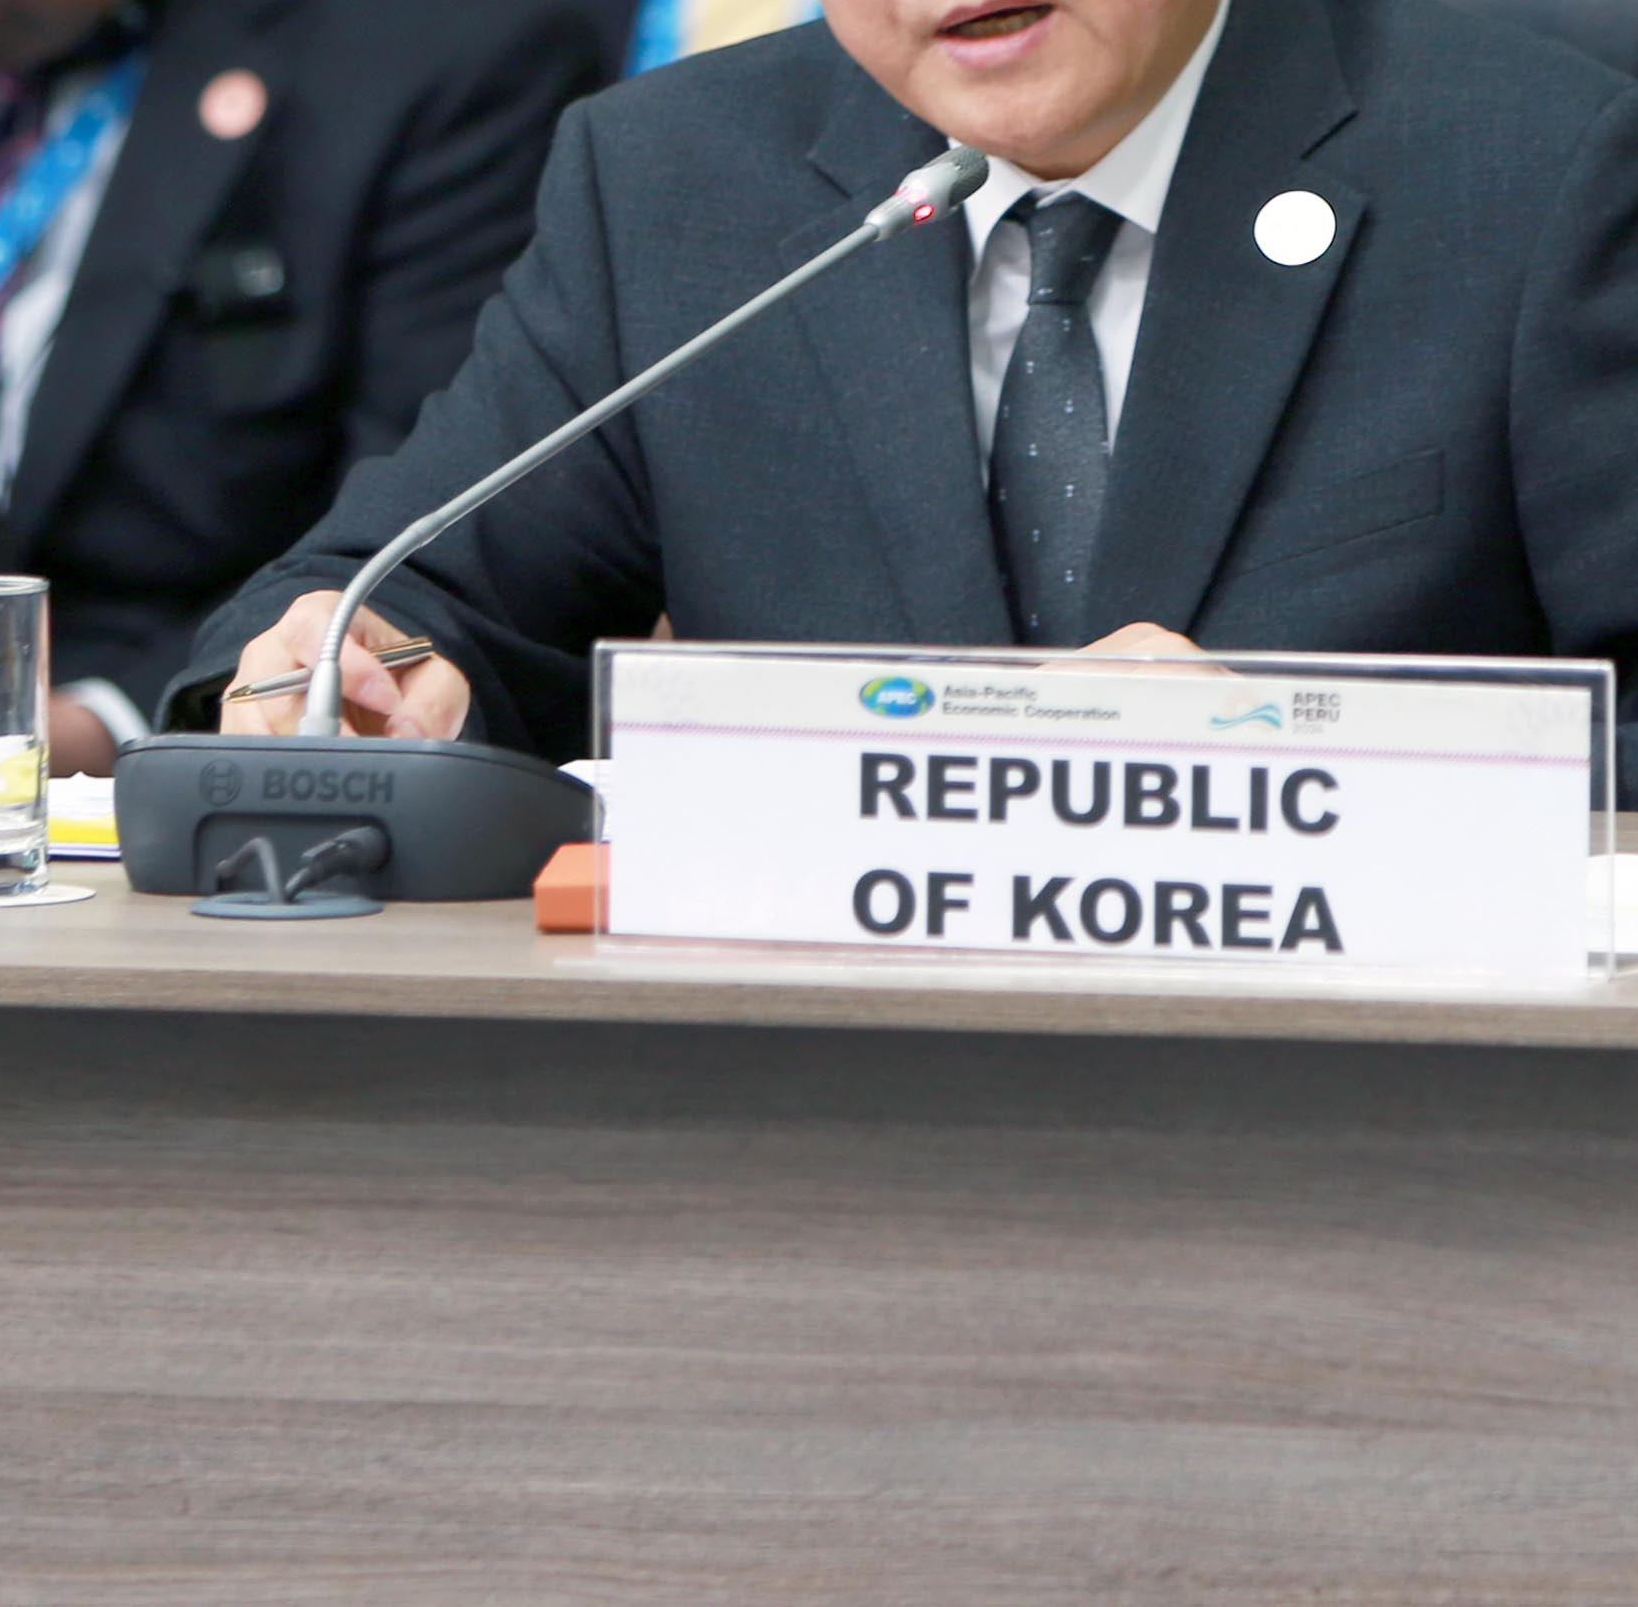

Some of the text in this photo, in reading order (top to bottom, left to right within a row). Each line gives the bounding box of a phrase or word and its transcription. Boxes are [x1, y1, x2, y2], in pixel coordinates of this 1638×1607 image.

[943, 685, 1038, 702] Asia-Pacific
[1292, 692, 1341, 708] APEC
[942, 701, 1122, 722] Economic Cooperation
[1292, 707, 1341, 723] PERU
[262, 767, 396, 804] BOSCH
[859, 751, 1341, 836] REPUBLIC
[852, 868, 1345, 954] OF KOREA
